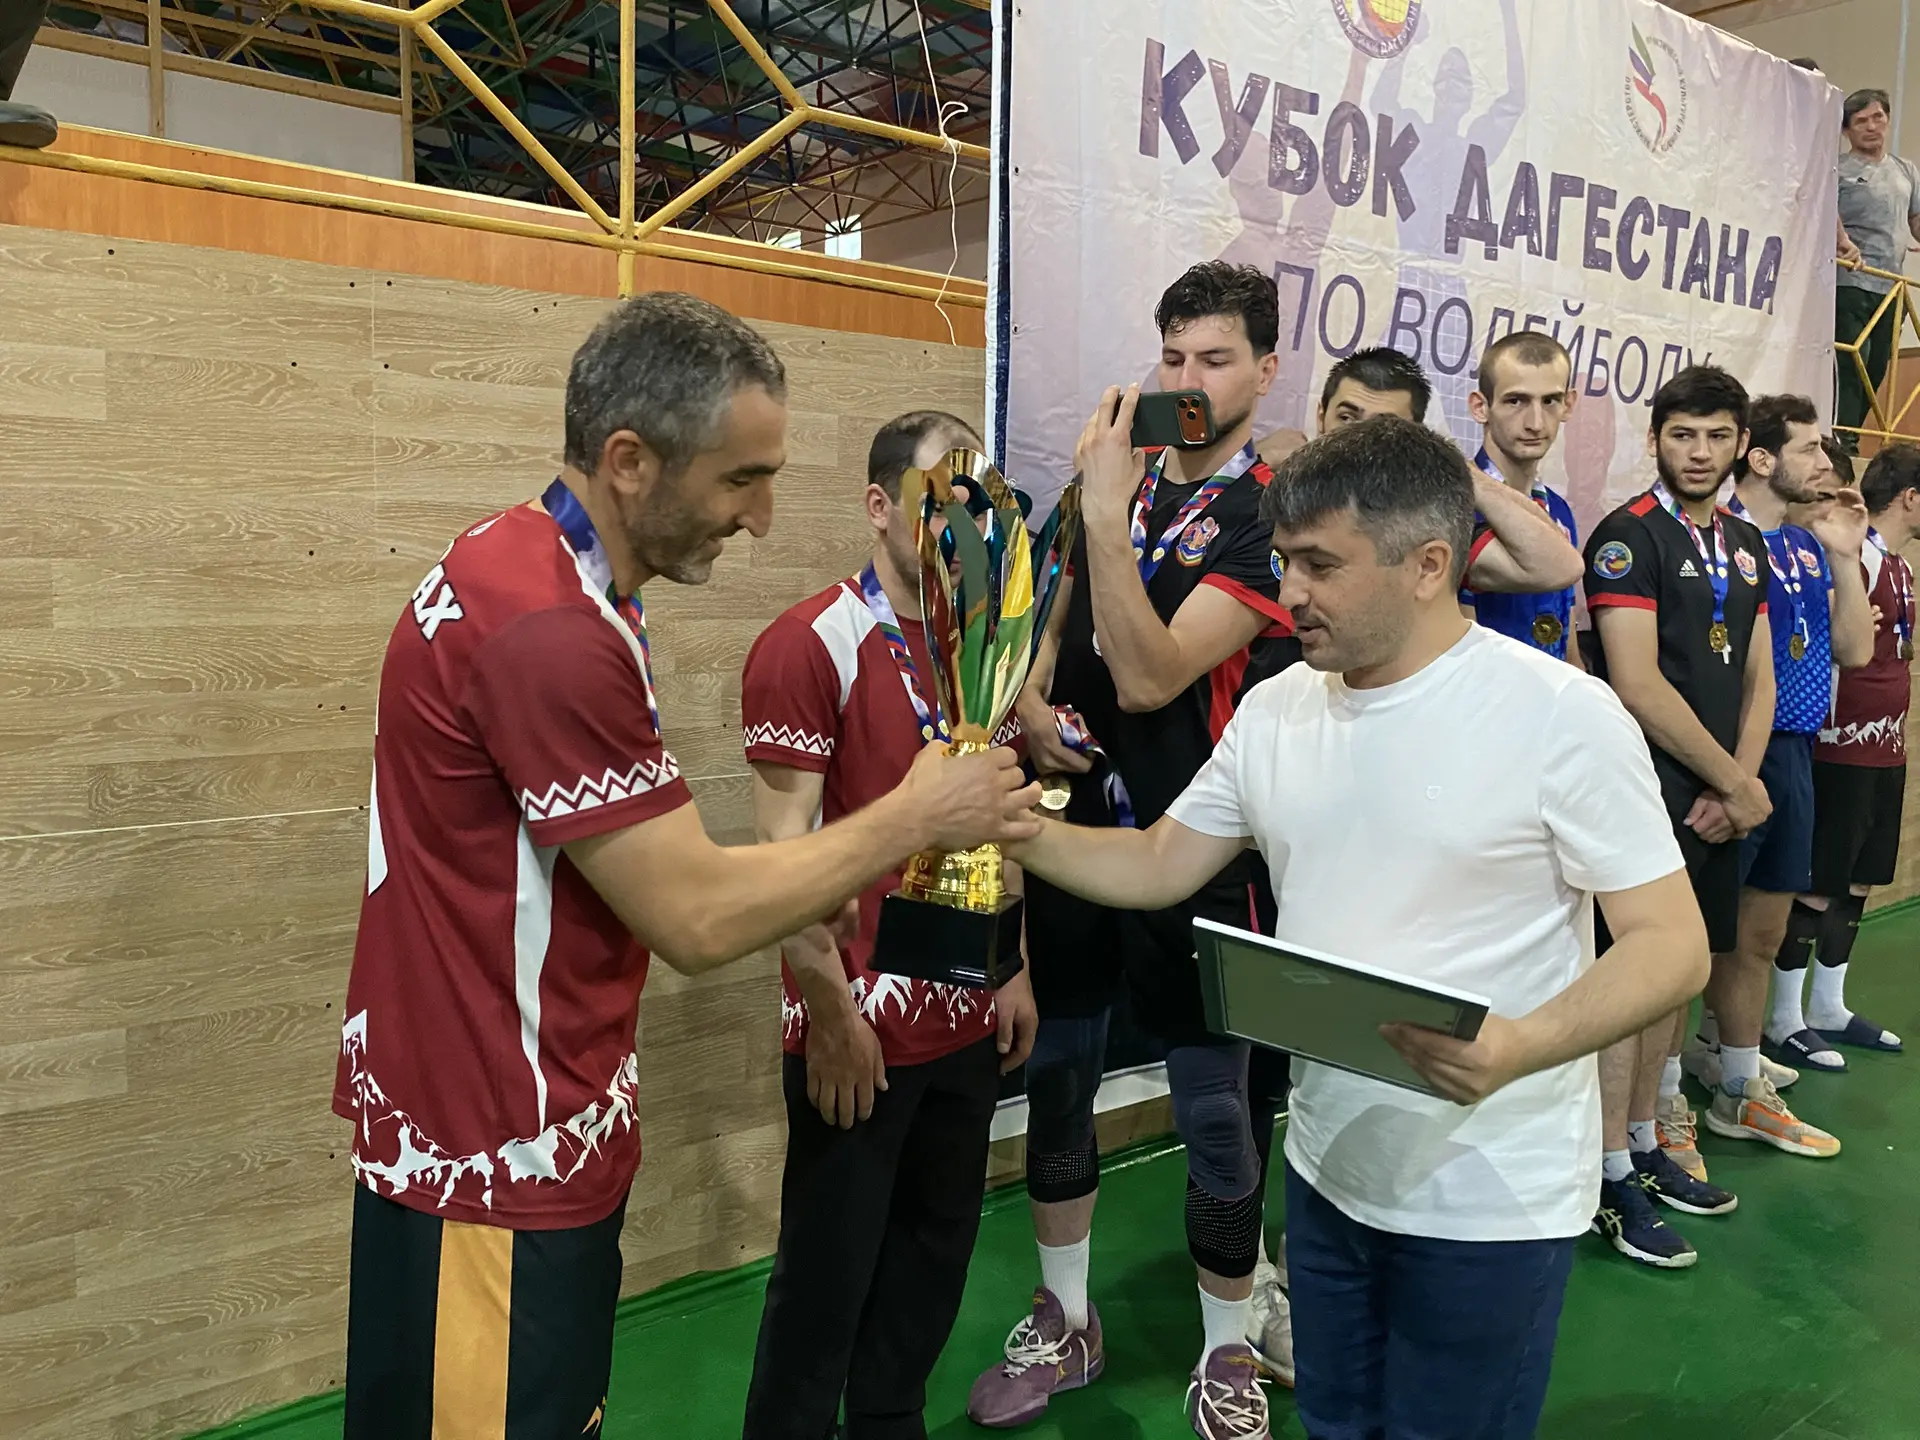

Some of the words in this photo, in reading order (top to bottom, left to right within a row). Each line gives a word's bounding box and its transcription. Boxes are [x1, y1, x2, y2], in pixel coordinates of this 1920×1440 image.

[1139, 37, 1420, 222] КУБОК
[1444, 143, 1783, 315] ДАГЕСТАНА
[1273, 260, 1366, 359] ПО
